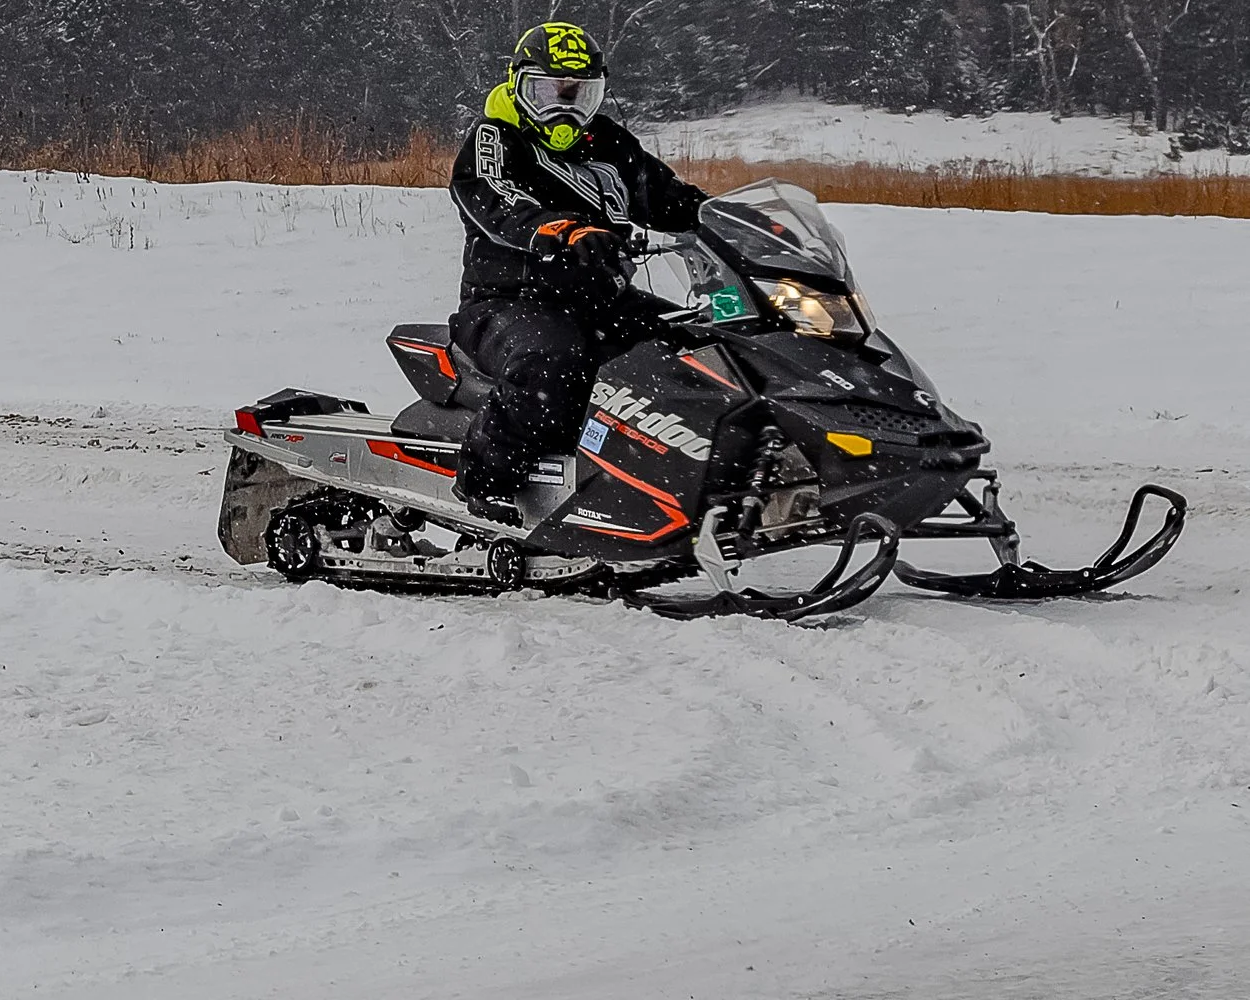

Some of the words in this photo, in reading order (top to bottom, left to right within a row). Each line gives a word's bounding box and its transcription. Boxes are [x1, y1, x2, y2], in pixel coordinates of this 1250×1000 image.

[584, 427, 604, 442] 2021
[590, 382, 713, 461] ski-doo
[594, 410, 669, 455] RENEGADE
[577, 507, 602, 520] ROTAX
